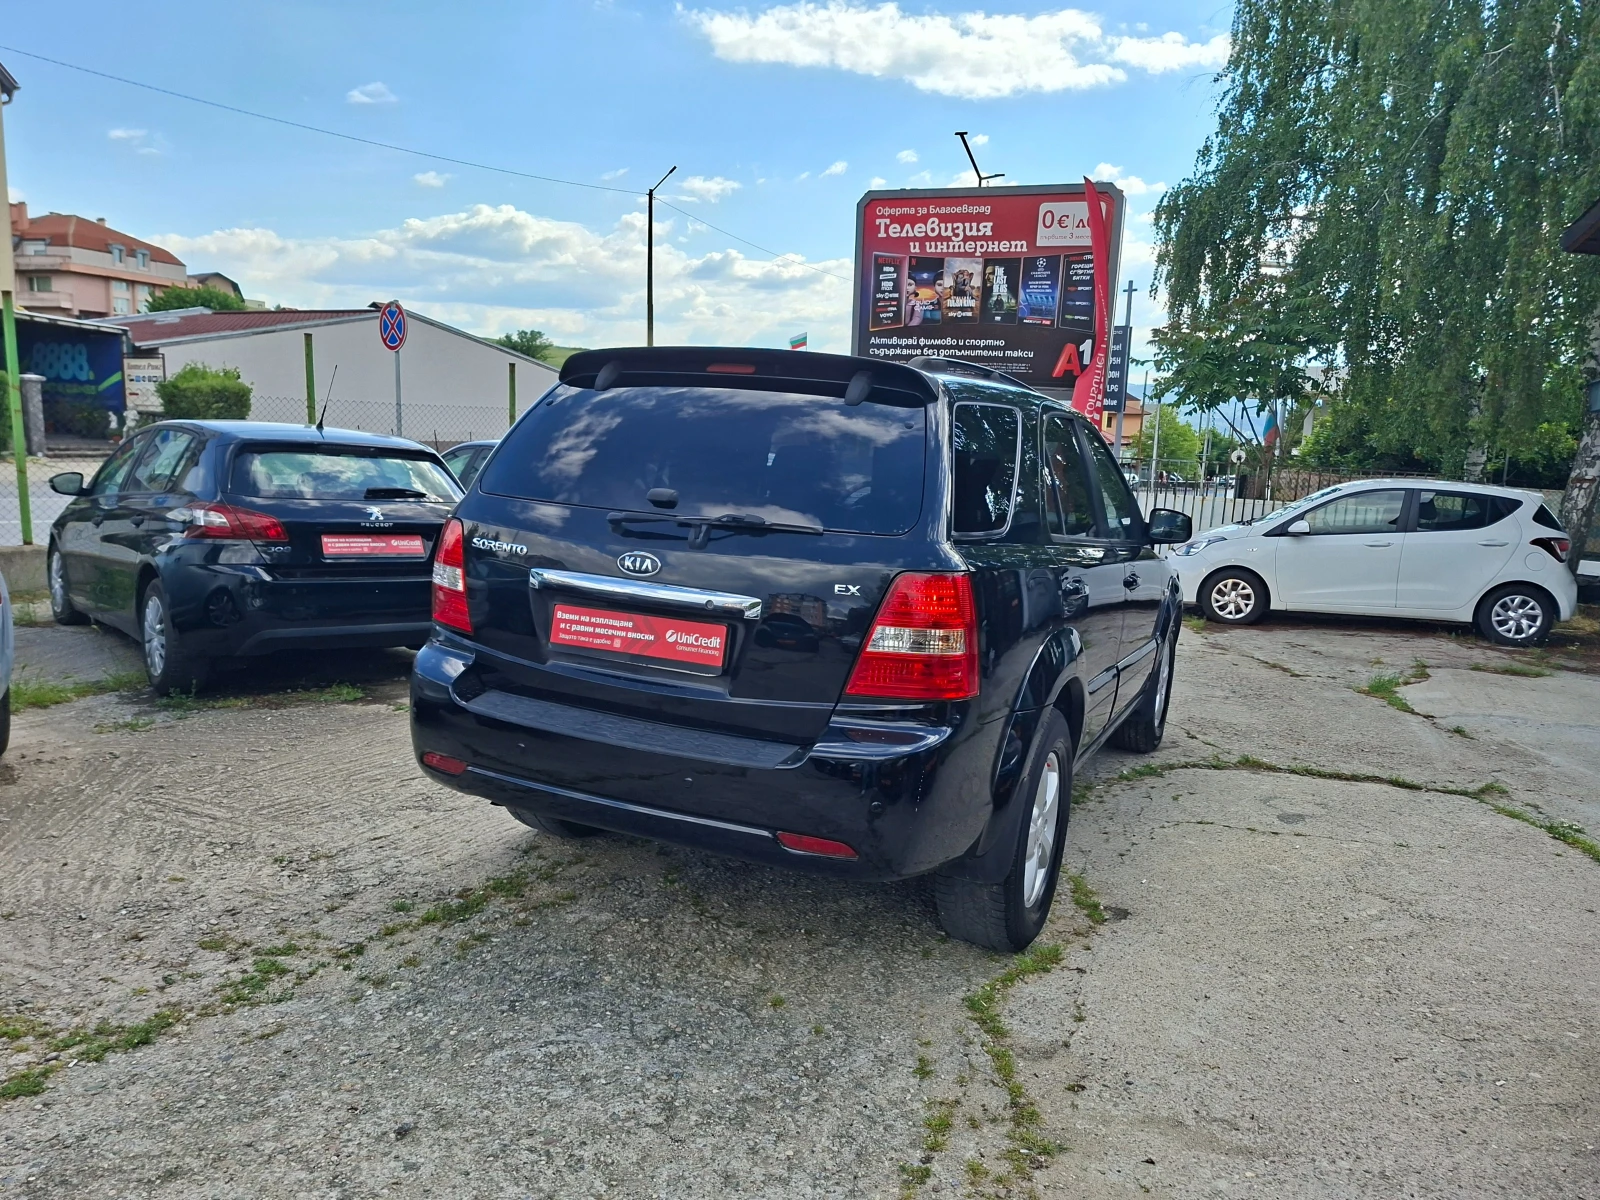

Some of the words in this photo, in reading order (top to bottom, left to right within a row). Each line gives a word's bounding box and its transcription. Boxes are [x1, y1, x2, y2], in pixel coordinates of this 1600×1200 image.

[876, 206, 915, 216] Оферта
[917, 207, 927, 216] за
[929, 204, 991, 215] Благоевград
[875, 217, 993, 242] Телевизия
[909, 242, 920, 253] и
[925, 240, 1028, 256] интернет
[869, 336, 918, 345] Активирай
[919, 337, 957, 347] филмово
[965, 338, 1005, 347] спортно
[869, 348, 922, 356] съдържание
[923, 347, 938, 357] без
[938, 349, 1004, 357] допълнителни
[1004, 349, 1034, 358] такси
[1052, 339, 1093, 378] A1
[1107, 384, 1119, 392] LPG
[471, 537, 528, 555] SORENTO
[623, 556, 653, 572] KIA
[834, 584, 861, 596] EX
[556, 611, 580, 621] Вземи
[591, 616, 633, 628] изплащане
[558, 632, 577, 641] Защото
[571, 624, 594, 633] равни
[595, 627, 626, 637] месечни
[627, 631, 654, 641] вноски
[677, 631, 721, 648] UniCredit
[676, 644, 697, 653] Consumer
[698, 647, 719, 656] Financing
